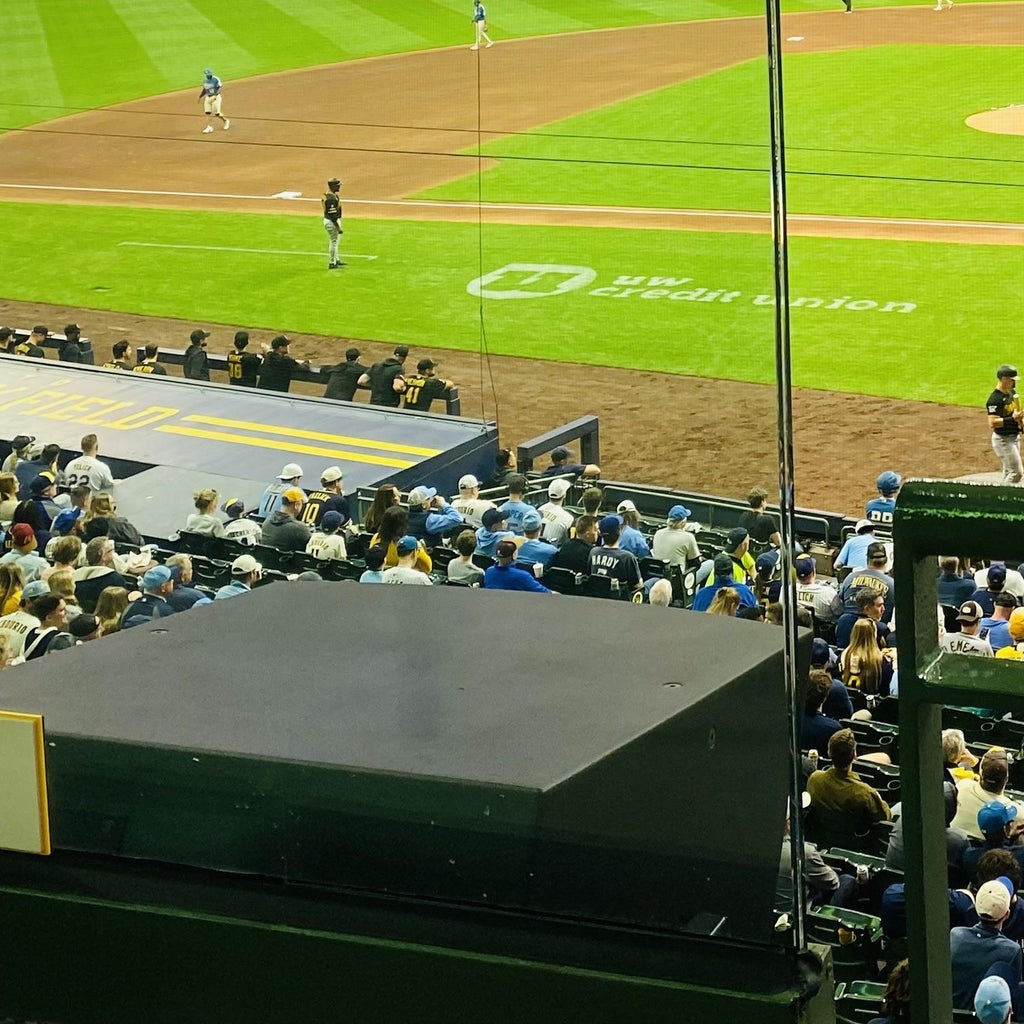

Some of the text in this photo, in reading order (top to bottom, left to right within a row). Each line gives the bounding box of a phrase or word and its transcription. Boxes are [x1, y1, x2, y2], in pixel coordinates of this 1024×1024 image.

[612, 274, 695, 288] uw
[588, 286, 918, 314] credit union
[405, 387, 421, 405] 41
[0, 389, 181, 431] FIELD
[302, 502, 320, 524] 10
[591, 554, 620, 569] HARDY
